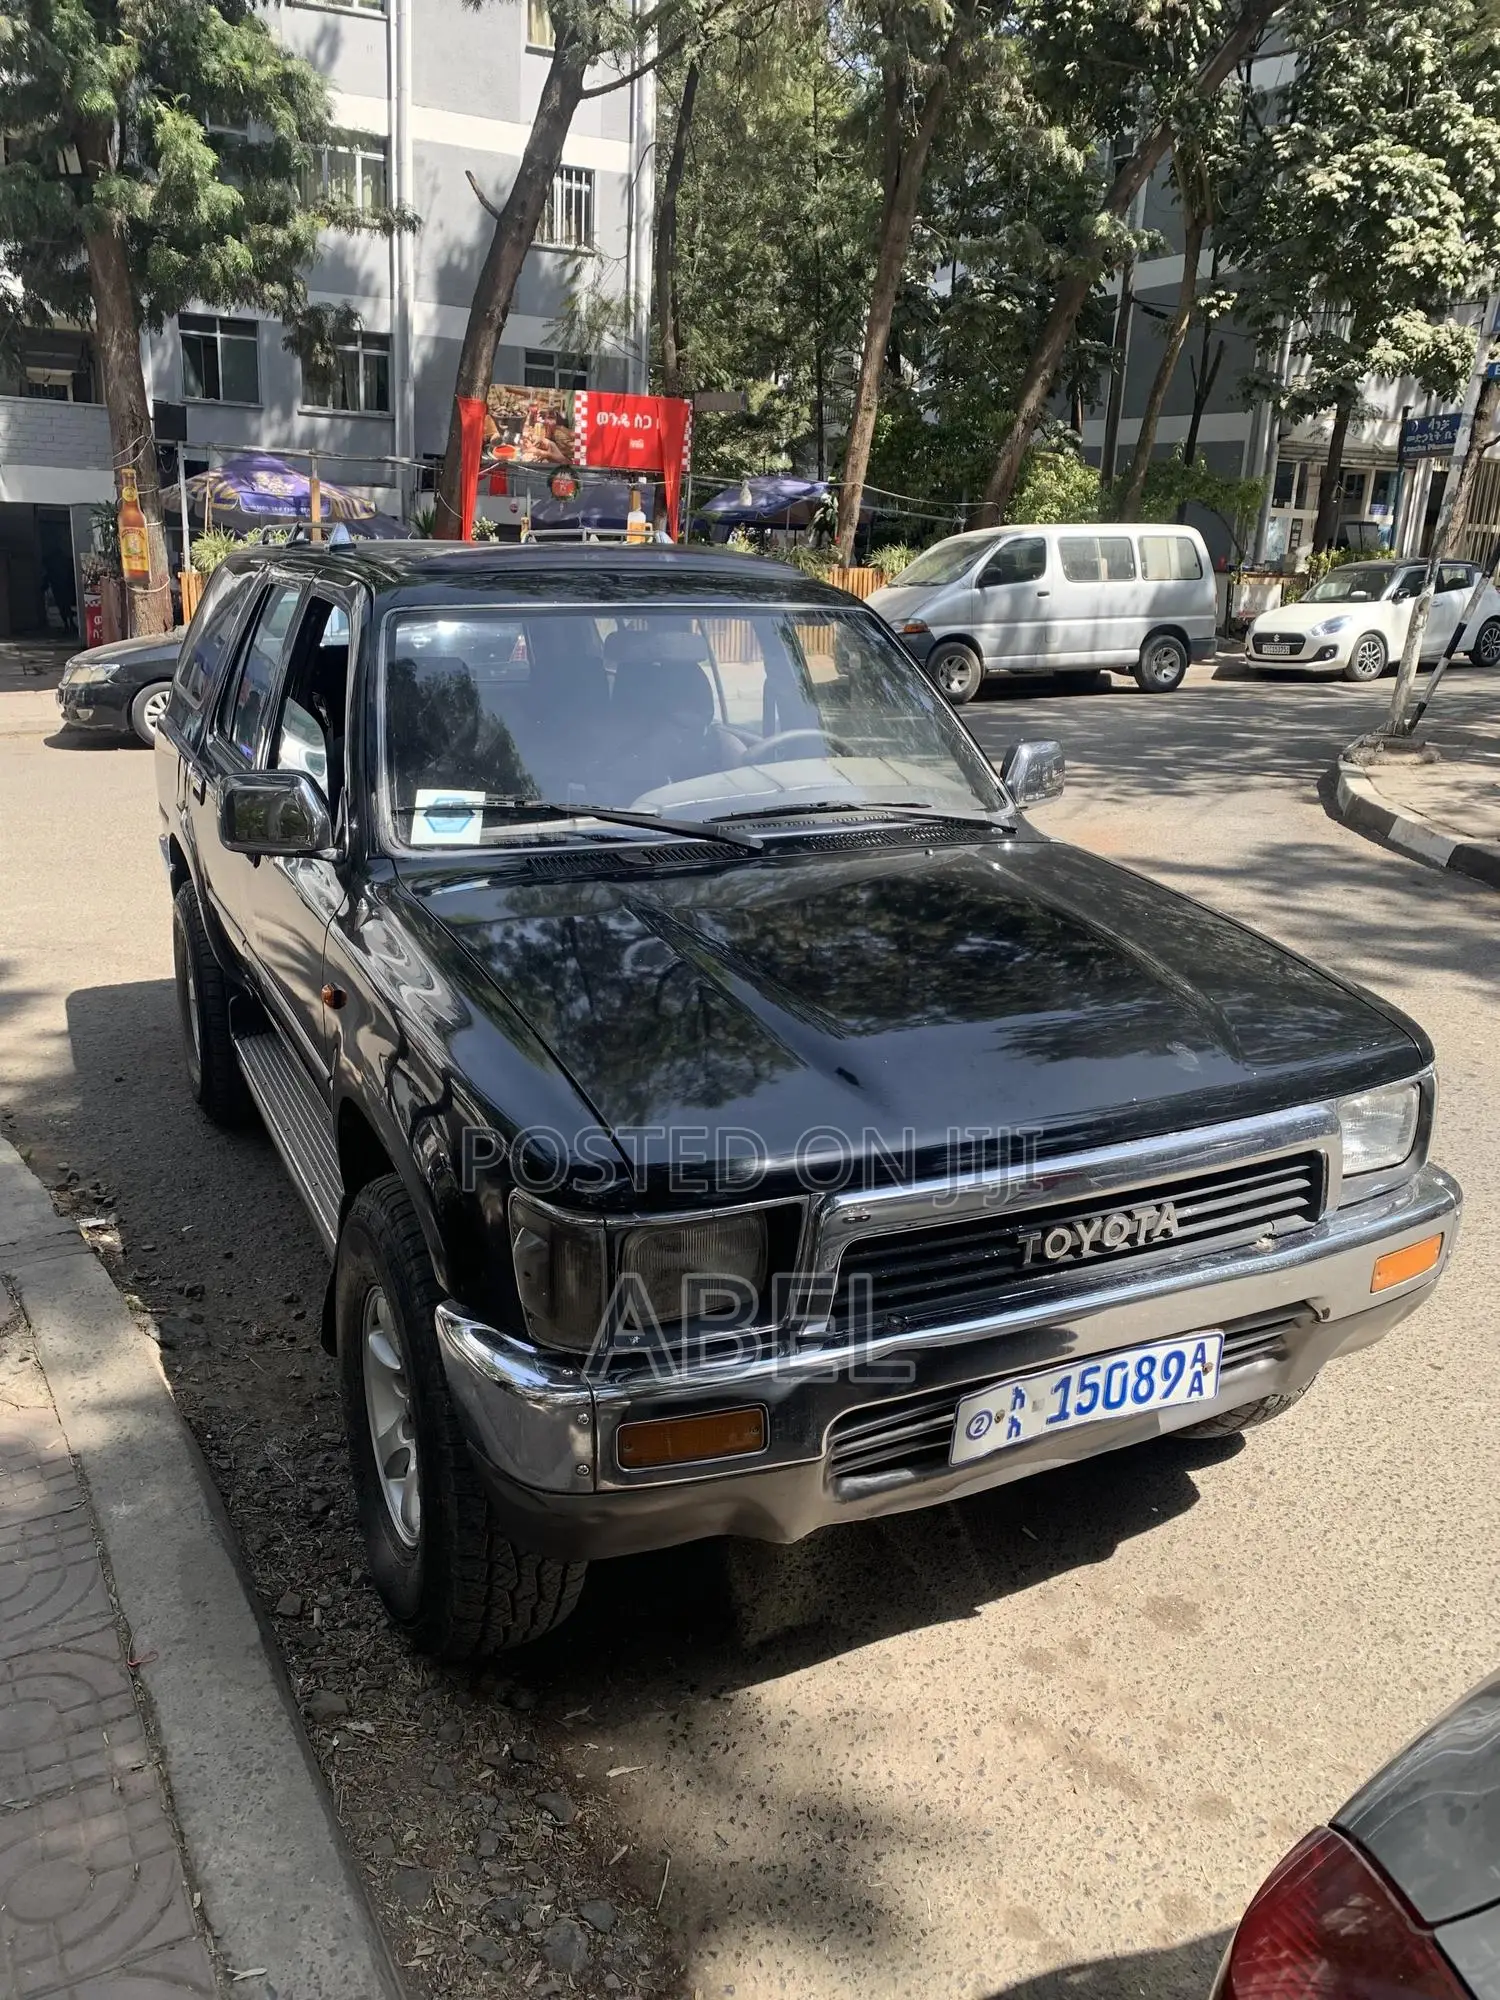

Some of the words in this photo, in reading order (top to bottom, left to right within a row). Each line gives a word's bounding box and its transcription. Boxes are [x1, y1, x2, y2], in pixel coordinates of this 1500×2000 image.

[634, 413, 652, 430] ስጋ
[1017, 1202, 1179, 1265] TOYOTA
[1046, 1349, 1186, 1425] 15089
[1186, 1370, 1204, 1398] A
